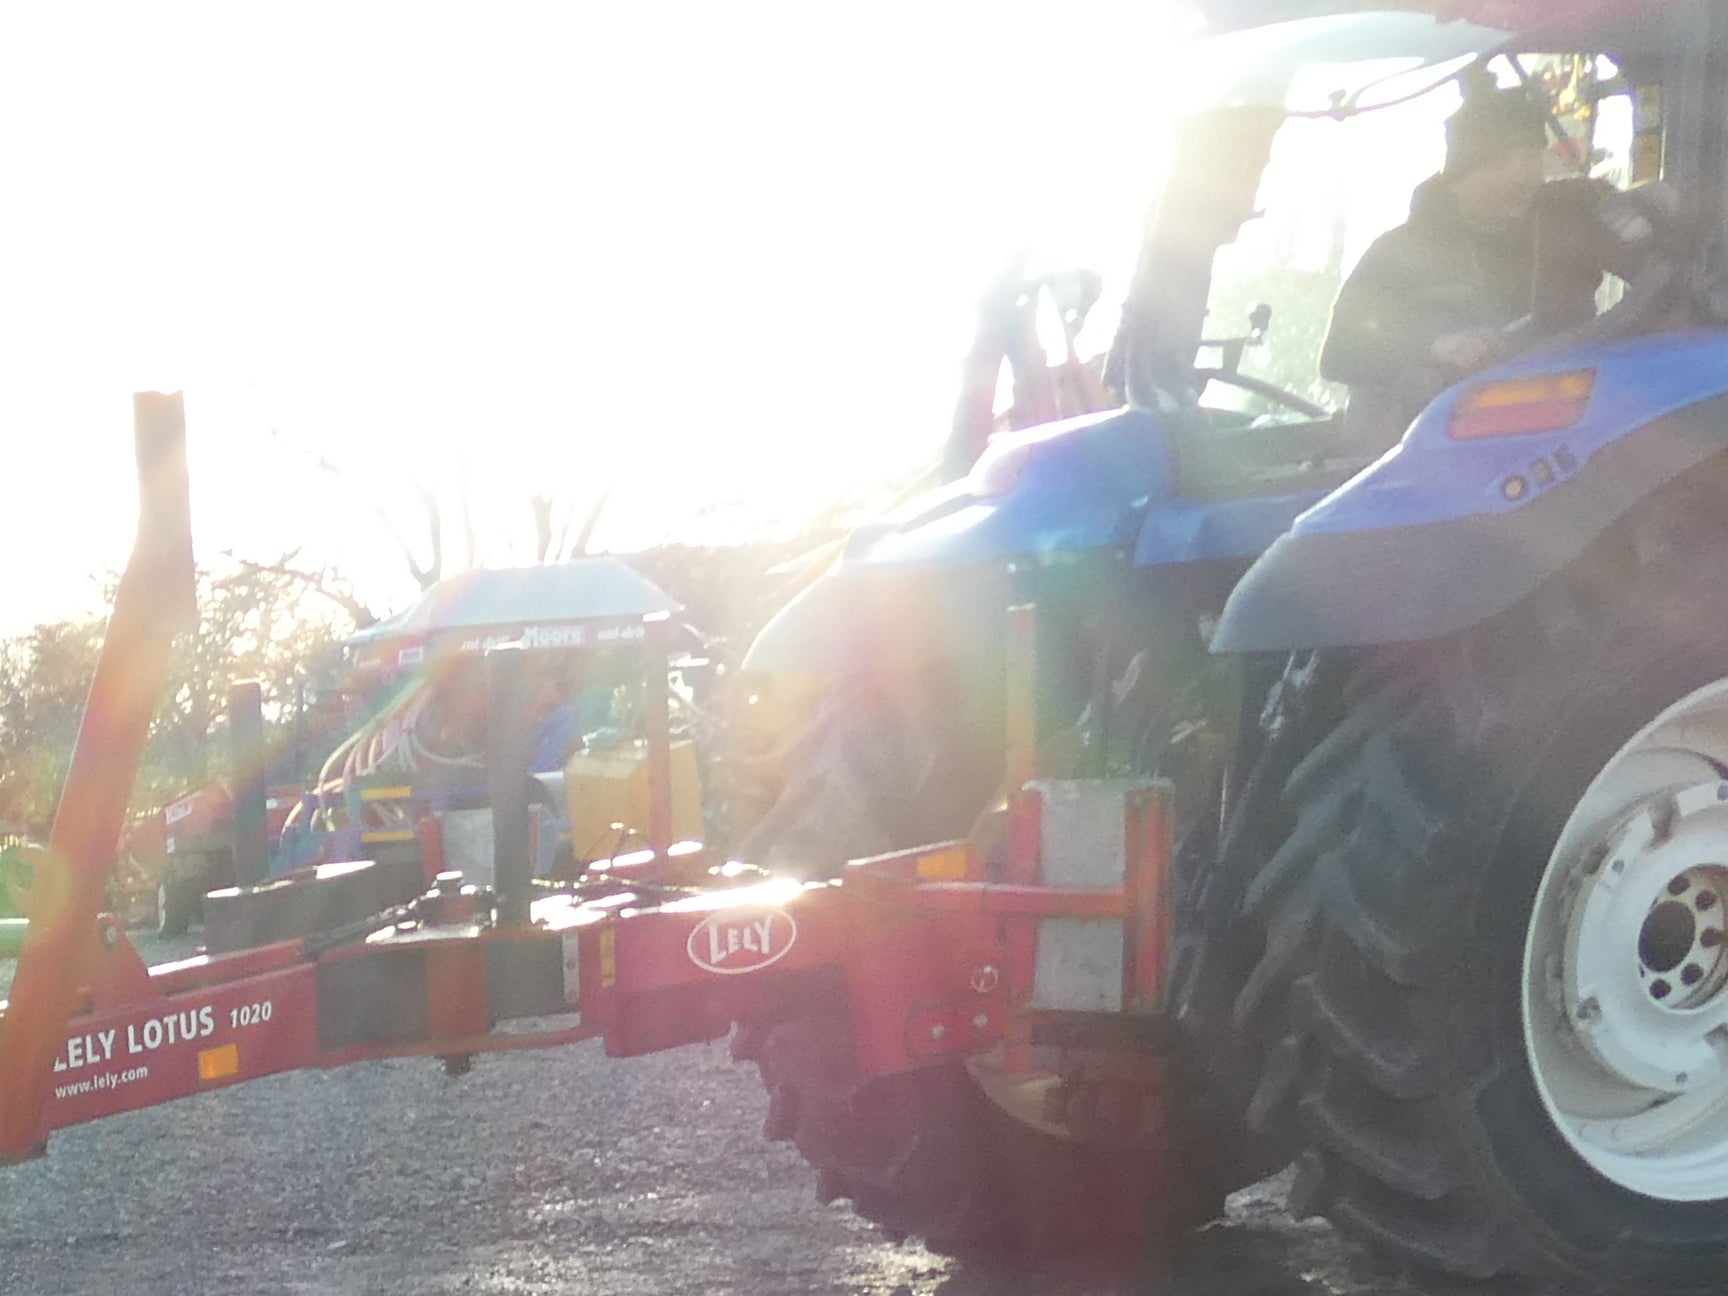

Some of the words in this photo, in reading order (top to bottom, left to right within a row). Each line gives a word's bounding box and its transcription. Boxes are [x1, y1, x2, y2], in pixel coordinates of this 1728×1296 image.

[708, 915, 773, 965] LELY
[127, 1005, 215, 1054] LOTUS
[229, 1001, 272, 1029] 1020
[55, 1065, 148, 1099] www.lely.com
